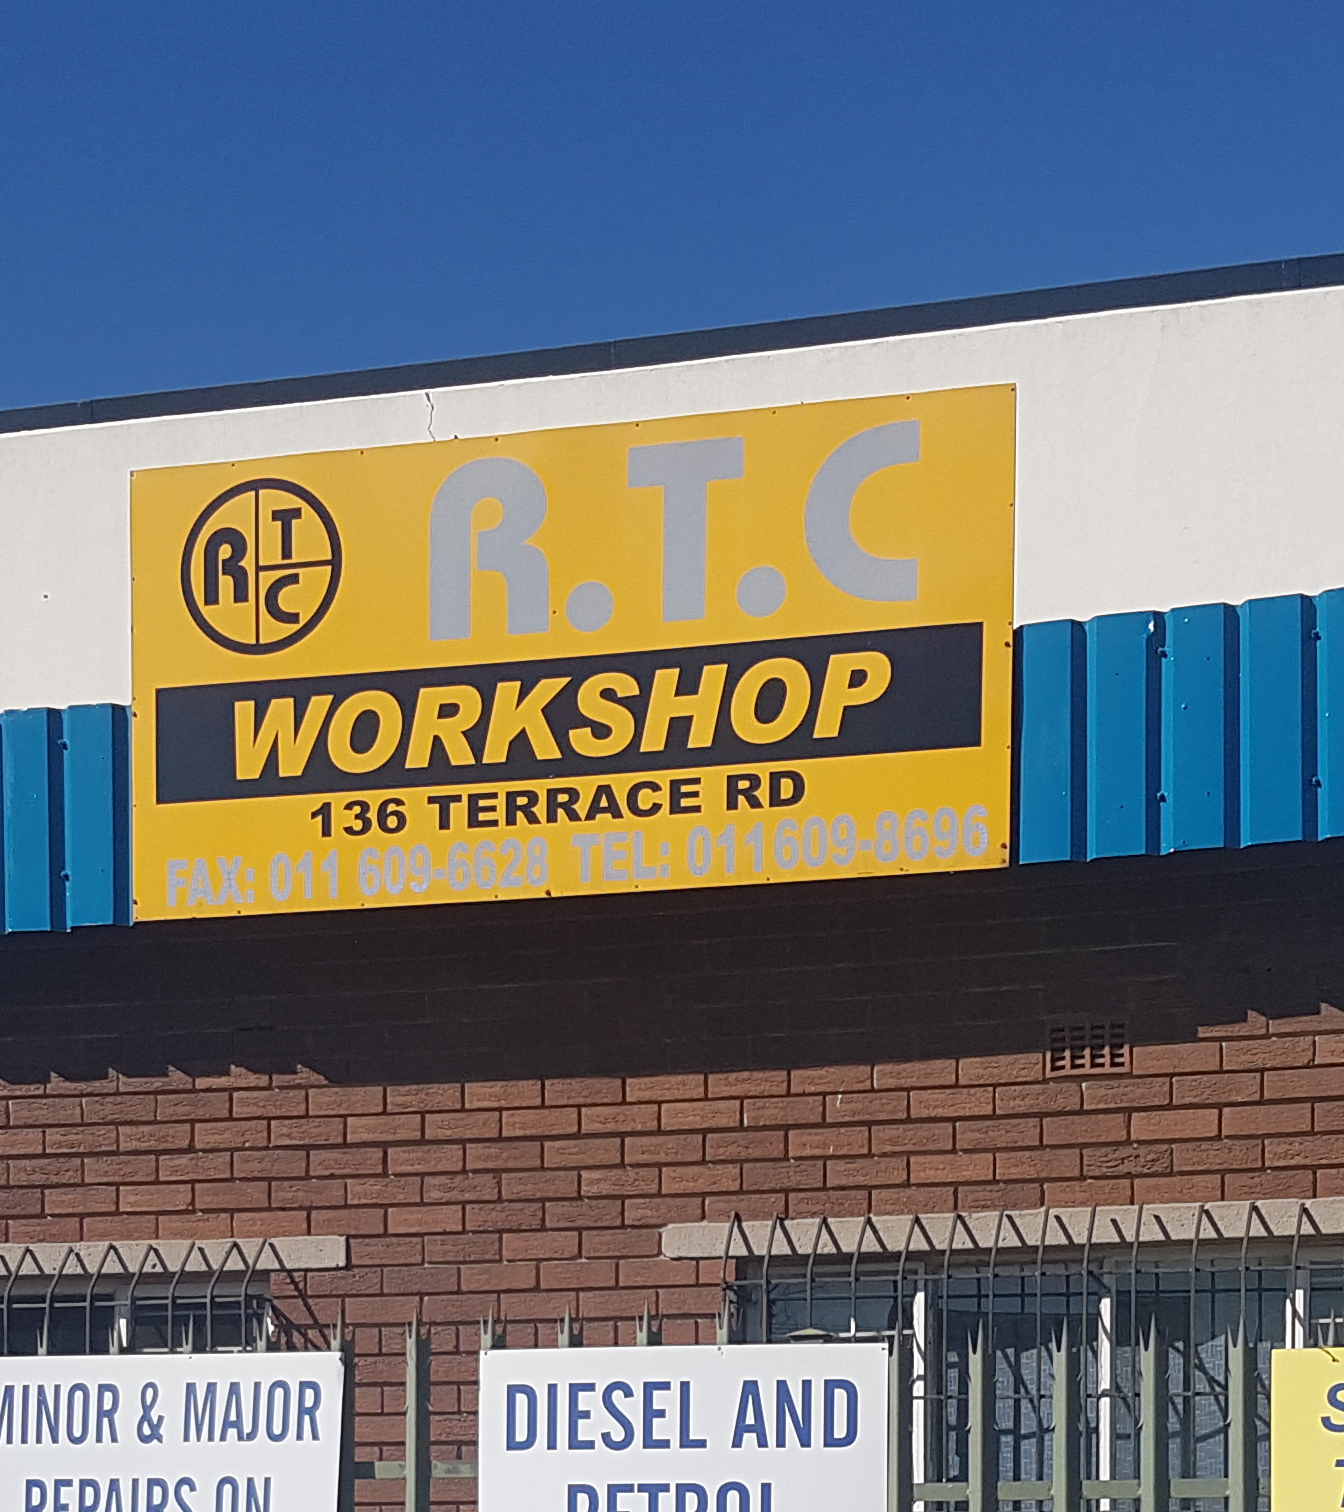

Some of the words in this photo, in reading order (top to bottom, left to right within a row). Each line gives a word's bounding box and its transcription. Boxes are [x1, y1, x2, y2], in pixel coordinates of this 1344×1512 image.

[429, 419, 921, 641] R.T.C
[232, 649, 892, 782] WORKSHOP
[309, 796, 407, 838] 136
[427, 780, 702, 832] TERRACE
[724, 770, 806, 812] RD
[165, 856, 256, 908] FAX:
[268, 852, 339, 901] 011
[358, 836, 549, 896] 609-6628
[573, 831, 672, 883] TEL:
[137, 1382, 165, 1444] &
[183, 1380, 322, 1443] MAJOR
[506, 1381, 707, 1451] DIESEL
[731, 1379, 858, 1448] AND
